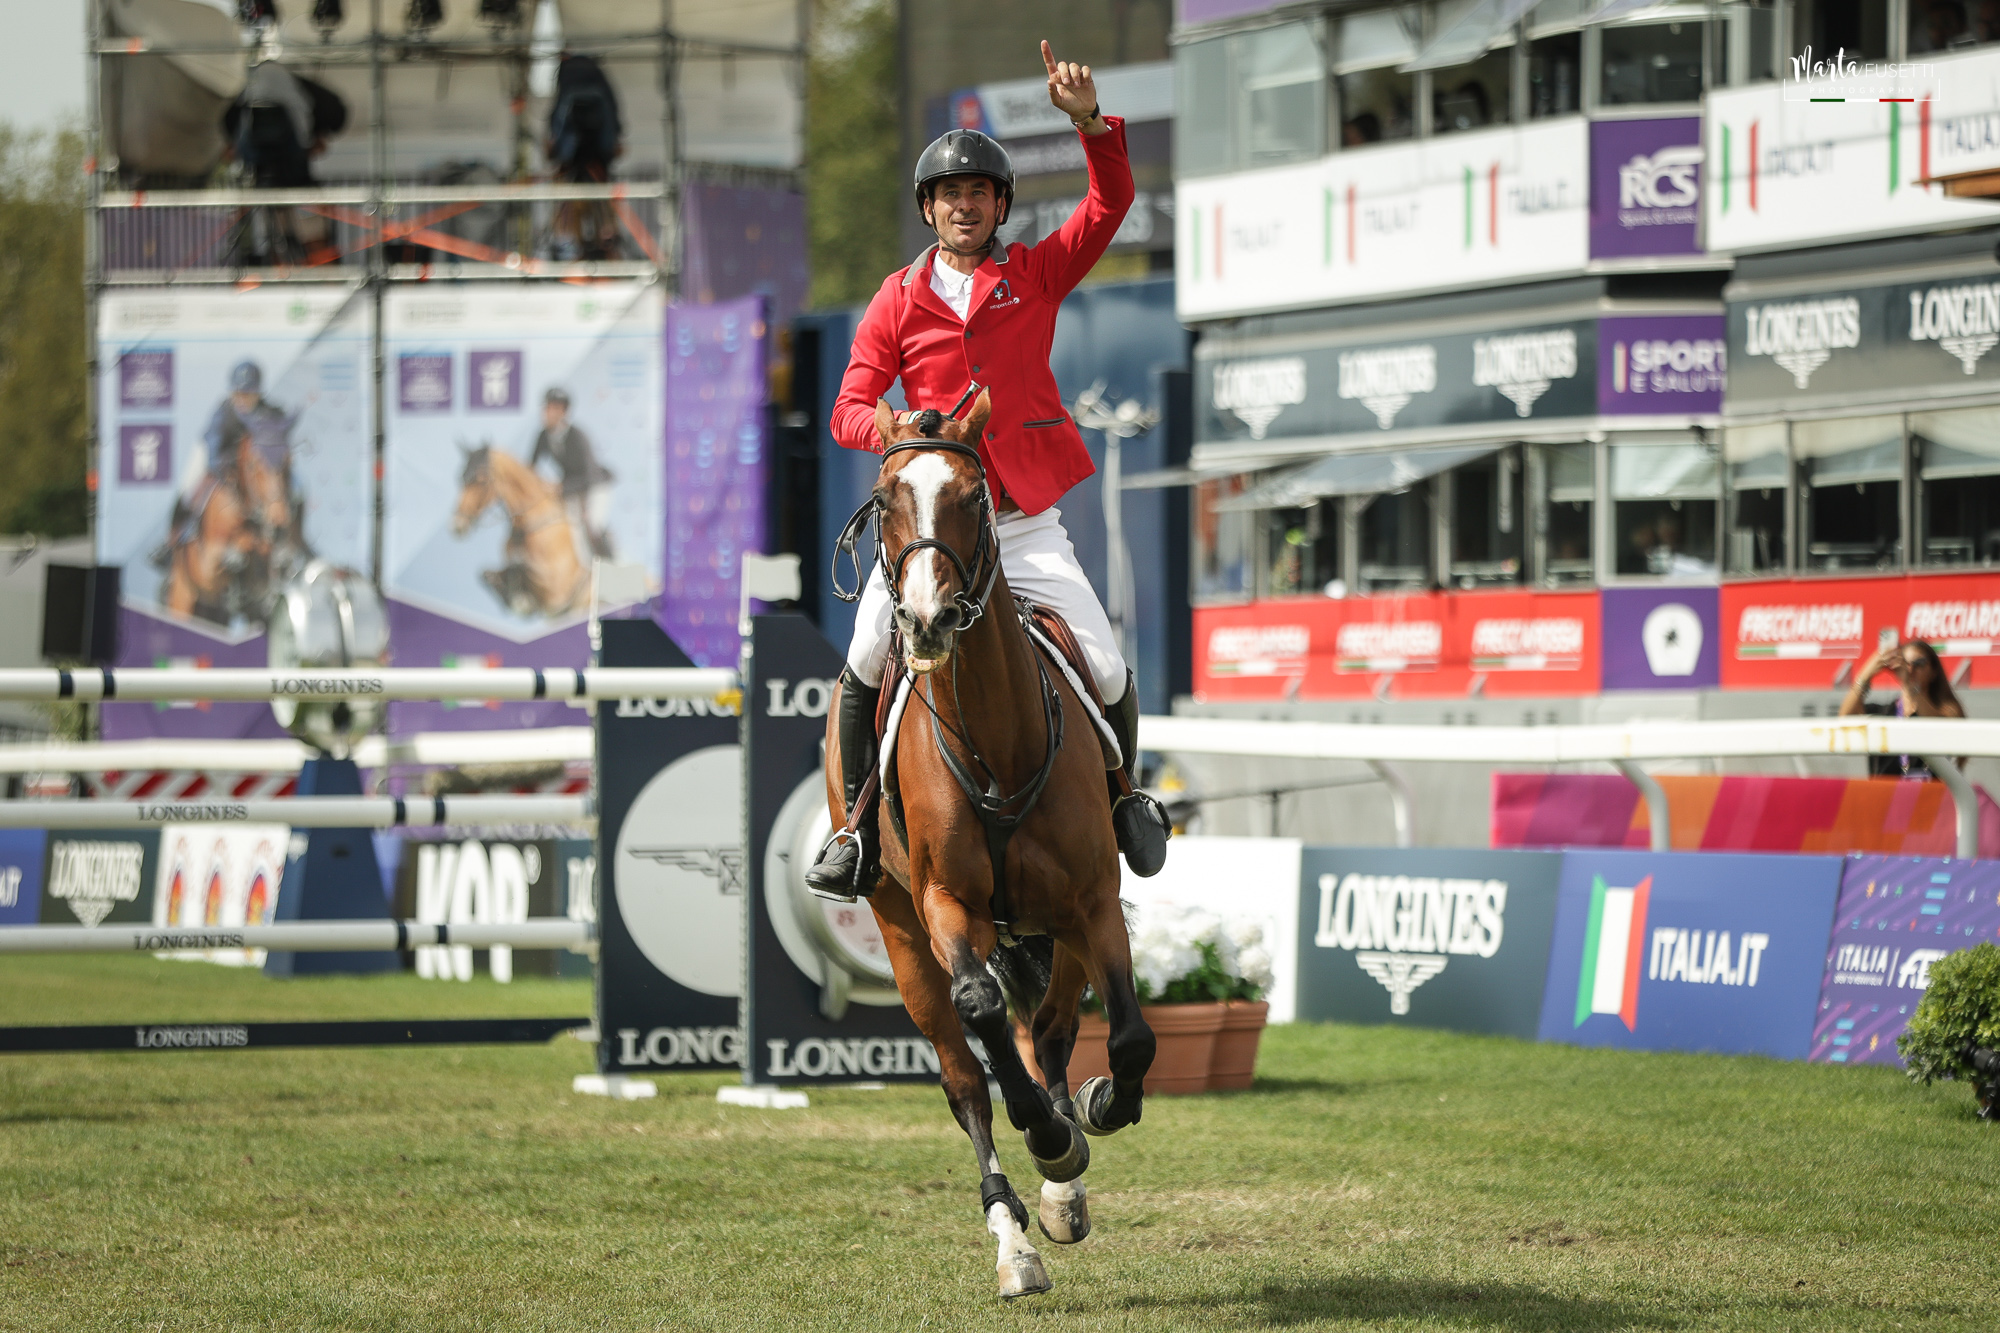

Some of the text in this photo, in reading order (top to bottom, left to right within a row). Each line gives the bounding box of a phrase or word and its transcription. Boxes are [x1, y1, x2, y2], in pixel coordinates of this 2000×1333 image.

[1618, 160, 1699, 208] RCS
[1745, 297, 1860, 356] LONGINES
[1473, 329, 1578, 386] LONGINES
[1631, 373, 1647, 393] E
[1738, 605, 1864, 640] FRECCIAROSSA
[271, 679, 385, 694] LONGINES
[138, 805, 249, 821] LONGINES
[1314, 872, 1508, 958] LONGINES
[134, 934, 245, 950] LONGINES
[1649, 927, 1769, 987] ITALIA.IT
[1836, 944, 1890, 974] ITALIA
[136, 1026, 248, 1047] LONGINES
